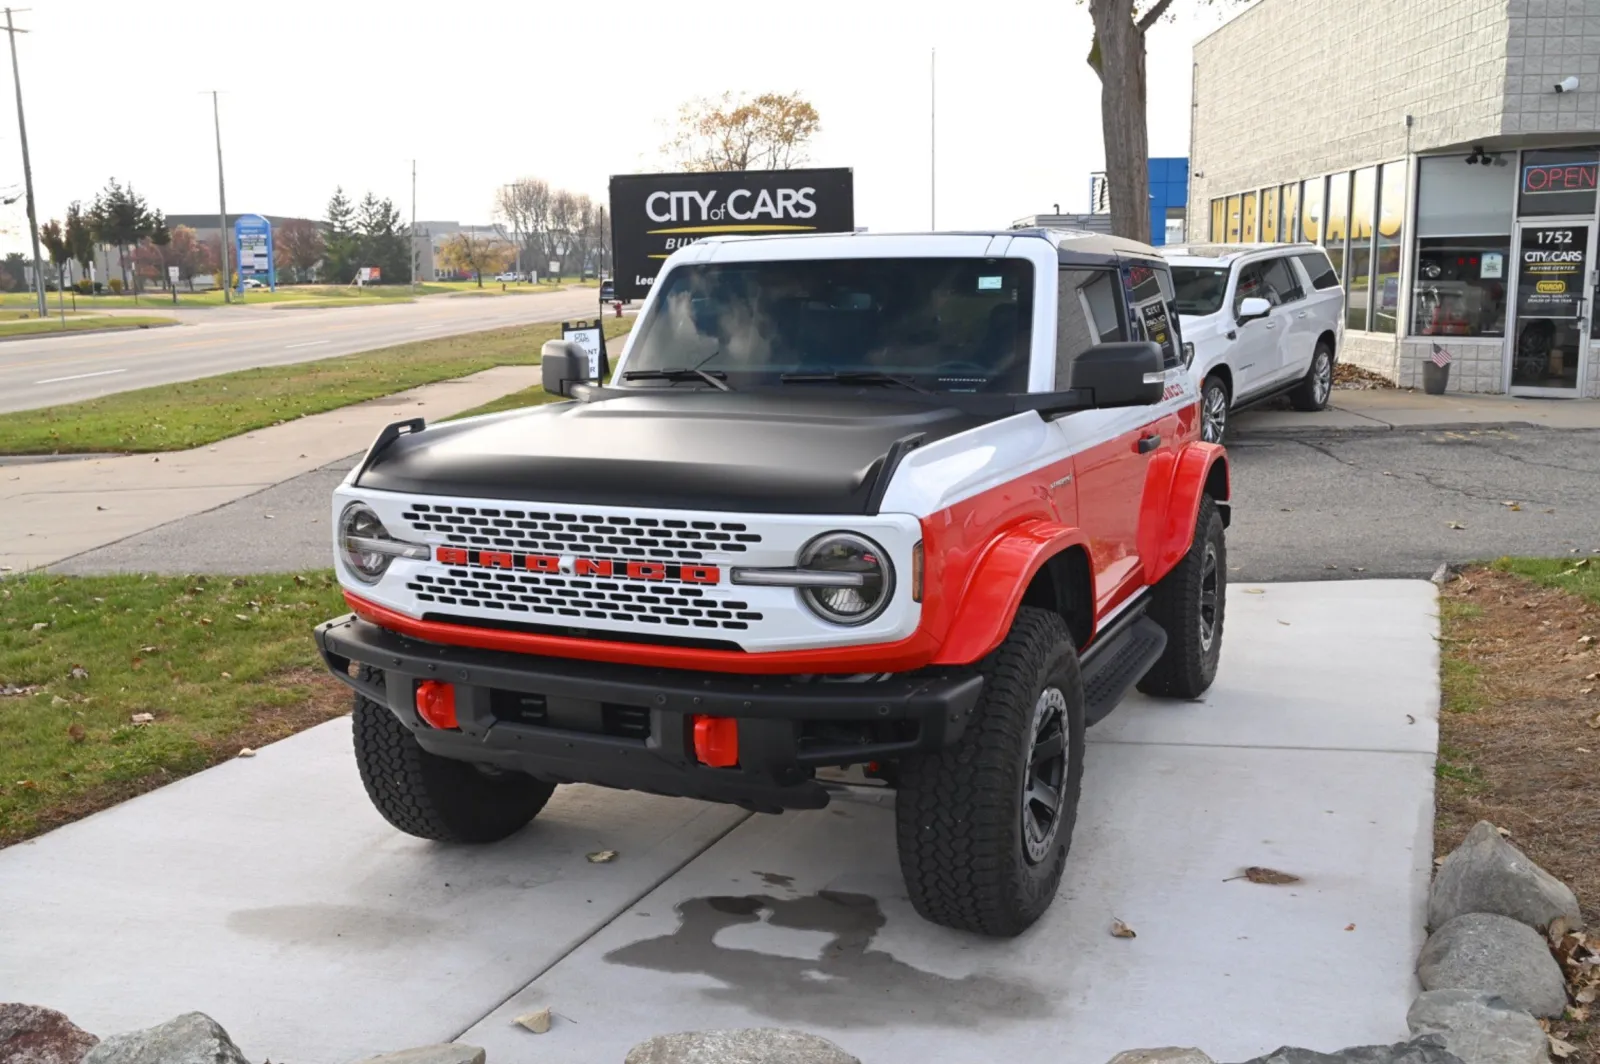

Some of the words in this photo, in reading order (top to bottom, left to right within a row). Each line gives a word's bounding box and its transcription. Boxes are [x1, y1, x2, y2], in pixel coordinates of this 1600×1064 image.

[1527, 166, 1596, 190] OPEN
[645, 189, 717, 223] CITY
[709, 202, 726, 221] of
[727, 186, 817, 220] CARS
[1213, 196, 1240, 243] WE
[1242, 183, 1297, 243] BUY
[1537, 231, 1573, 244] 1752
[1525, 251, 1548, 262] CITY
[1552, 250, 1582, 262] CARS
[1160, 384, 1184, 400] ONCO
[436, 546, 720, 585] BRONCO
